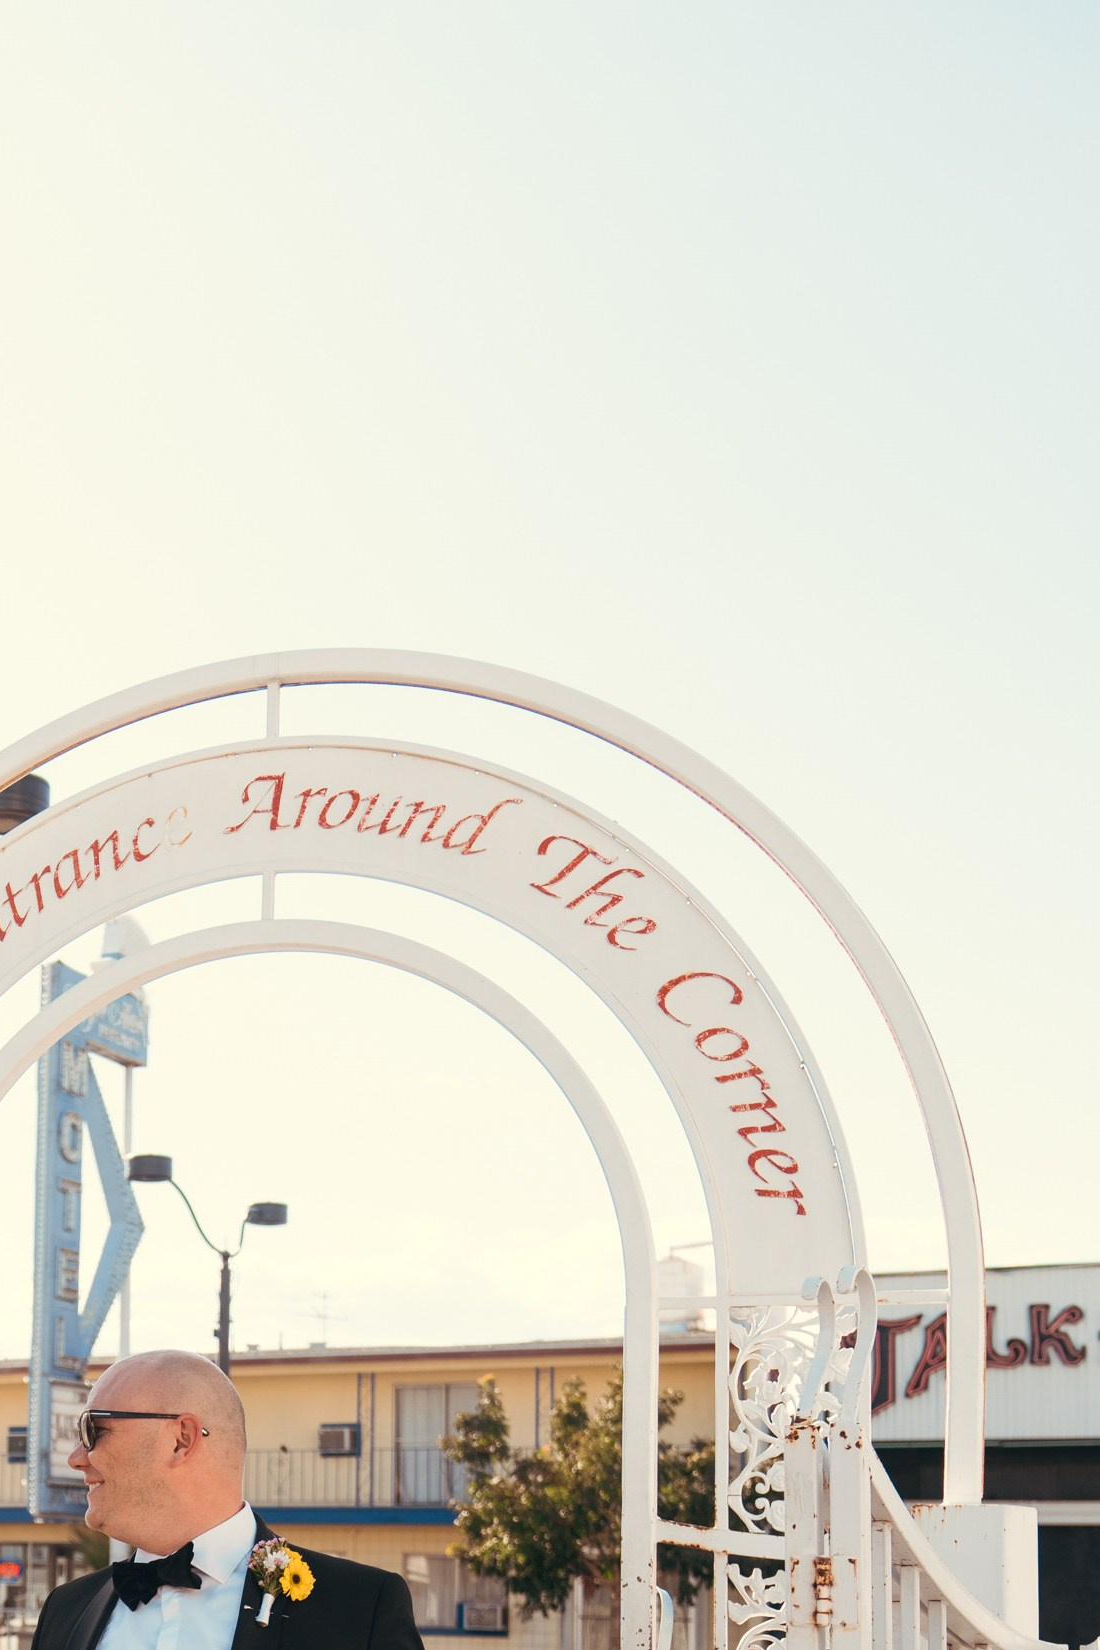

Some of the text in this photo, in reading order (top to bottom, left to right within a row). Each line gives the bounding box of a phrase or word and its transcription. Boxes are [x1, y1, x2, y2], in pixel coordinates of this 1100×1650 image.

[222, 772, 524, 856] Around
[529, 834, 659, 951] The
[656, 970, 807, 1216] Corner
[52, 1039, 88, 1373] MOTEL
